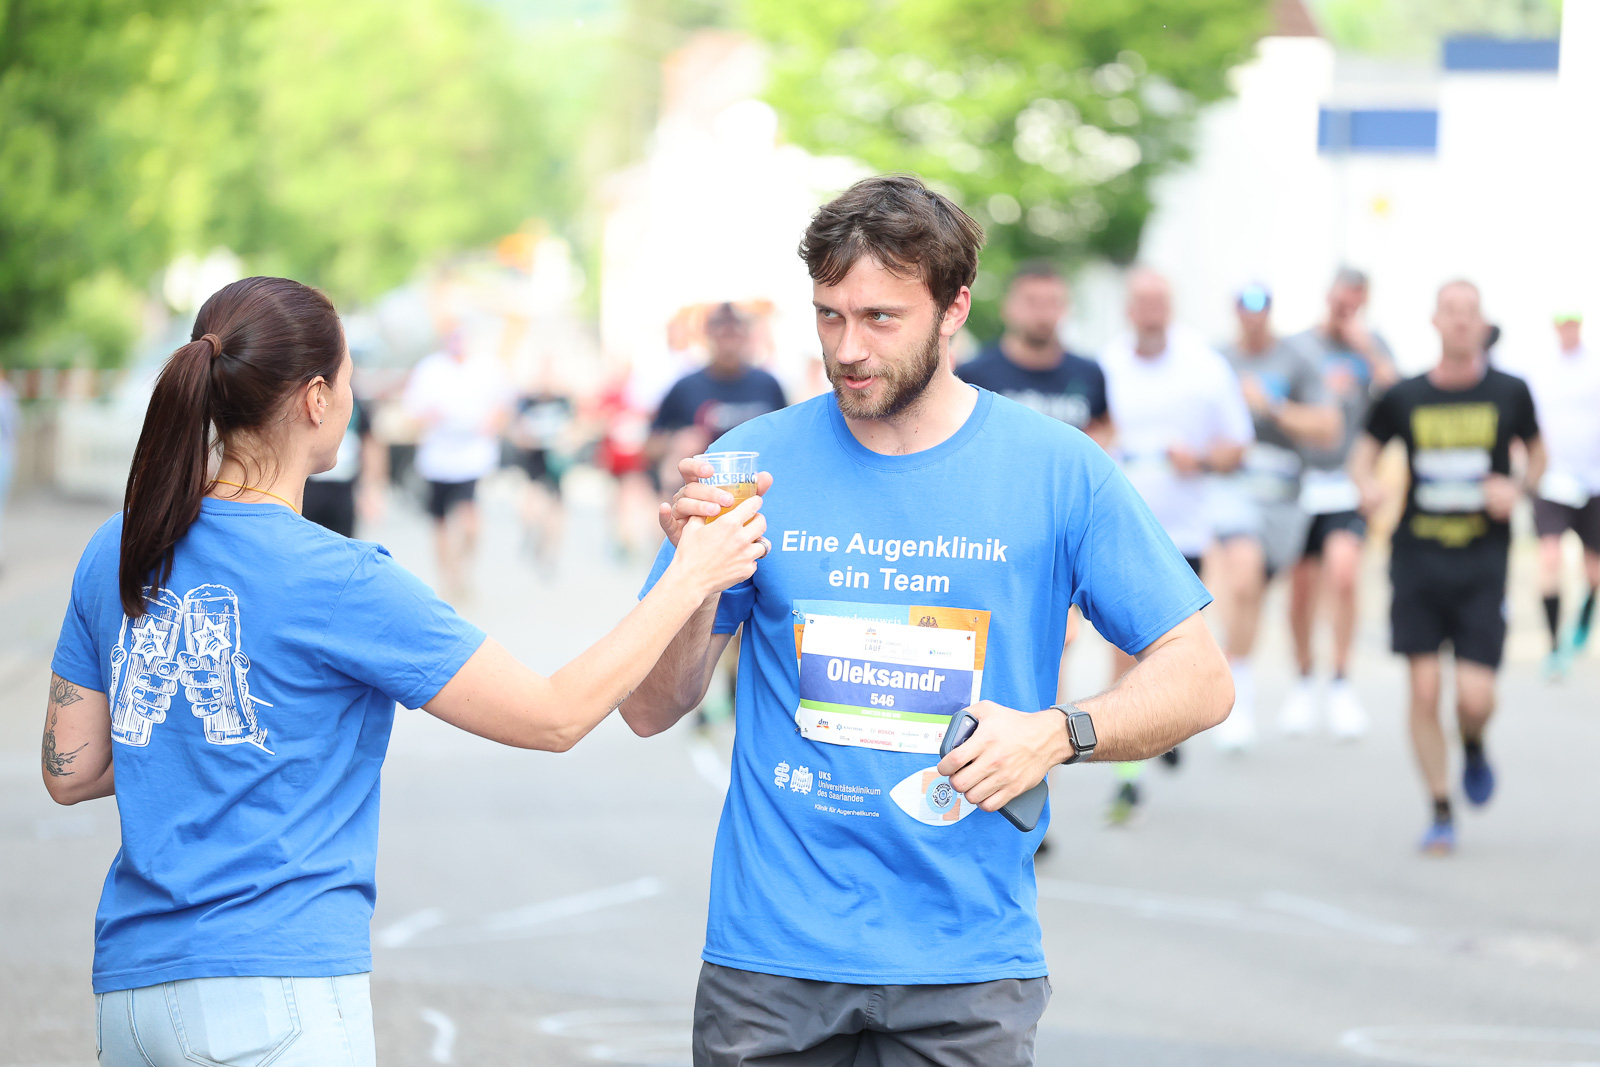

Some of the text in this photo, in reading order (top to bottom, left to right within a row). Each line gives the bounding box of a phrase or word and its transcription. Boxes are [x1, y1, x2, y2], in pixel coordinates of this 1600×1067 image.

[781, 530, 1008, 562] Eine Augenklinik
[828, 566, 950, 593] ein Team
[864, 644, 882, 652] LAUF
[827, 658, 946, 692] Oleksandr
[870, 693, 895, 707] 546
[818, 718, 829, 726] dm
[818, 770, 832, 781] UKS
[818, 780, 882, 796] Universitätsklinikum
[817, 789, 864, 803] des Saarlandes
[814, 803, 828, 812] Klinik
[836, 808, 880, 818] Augenheilkunde
